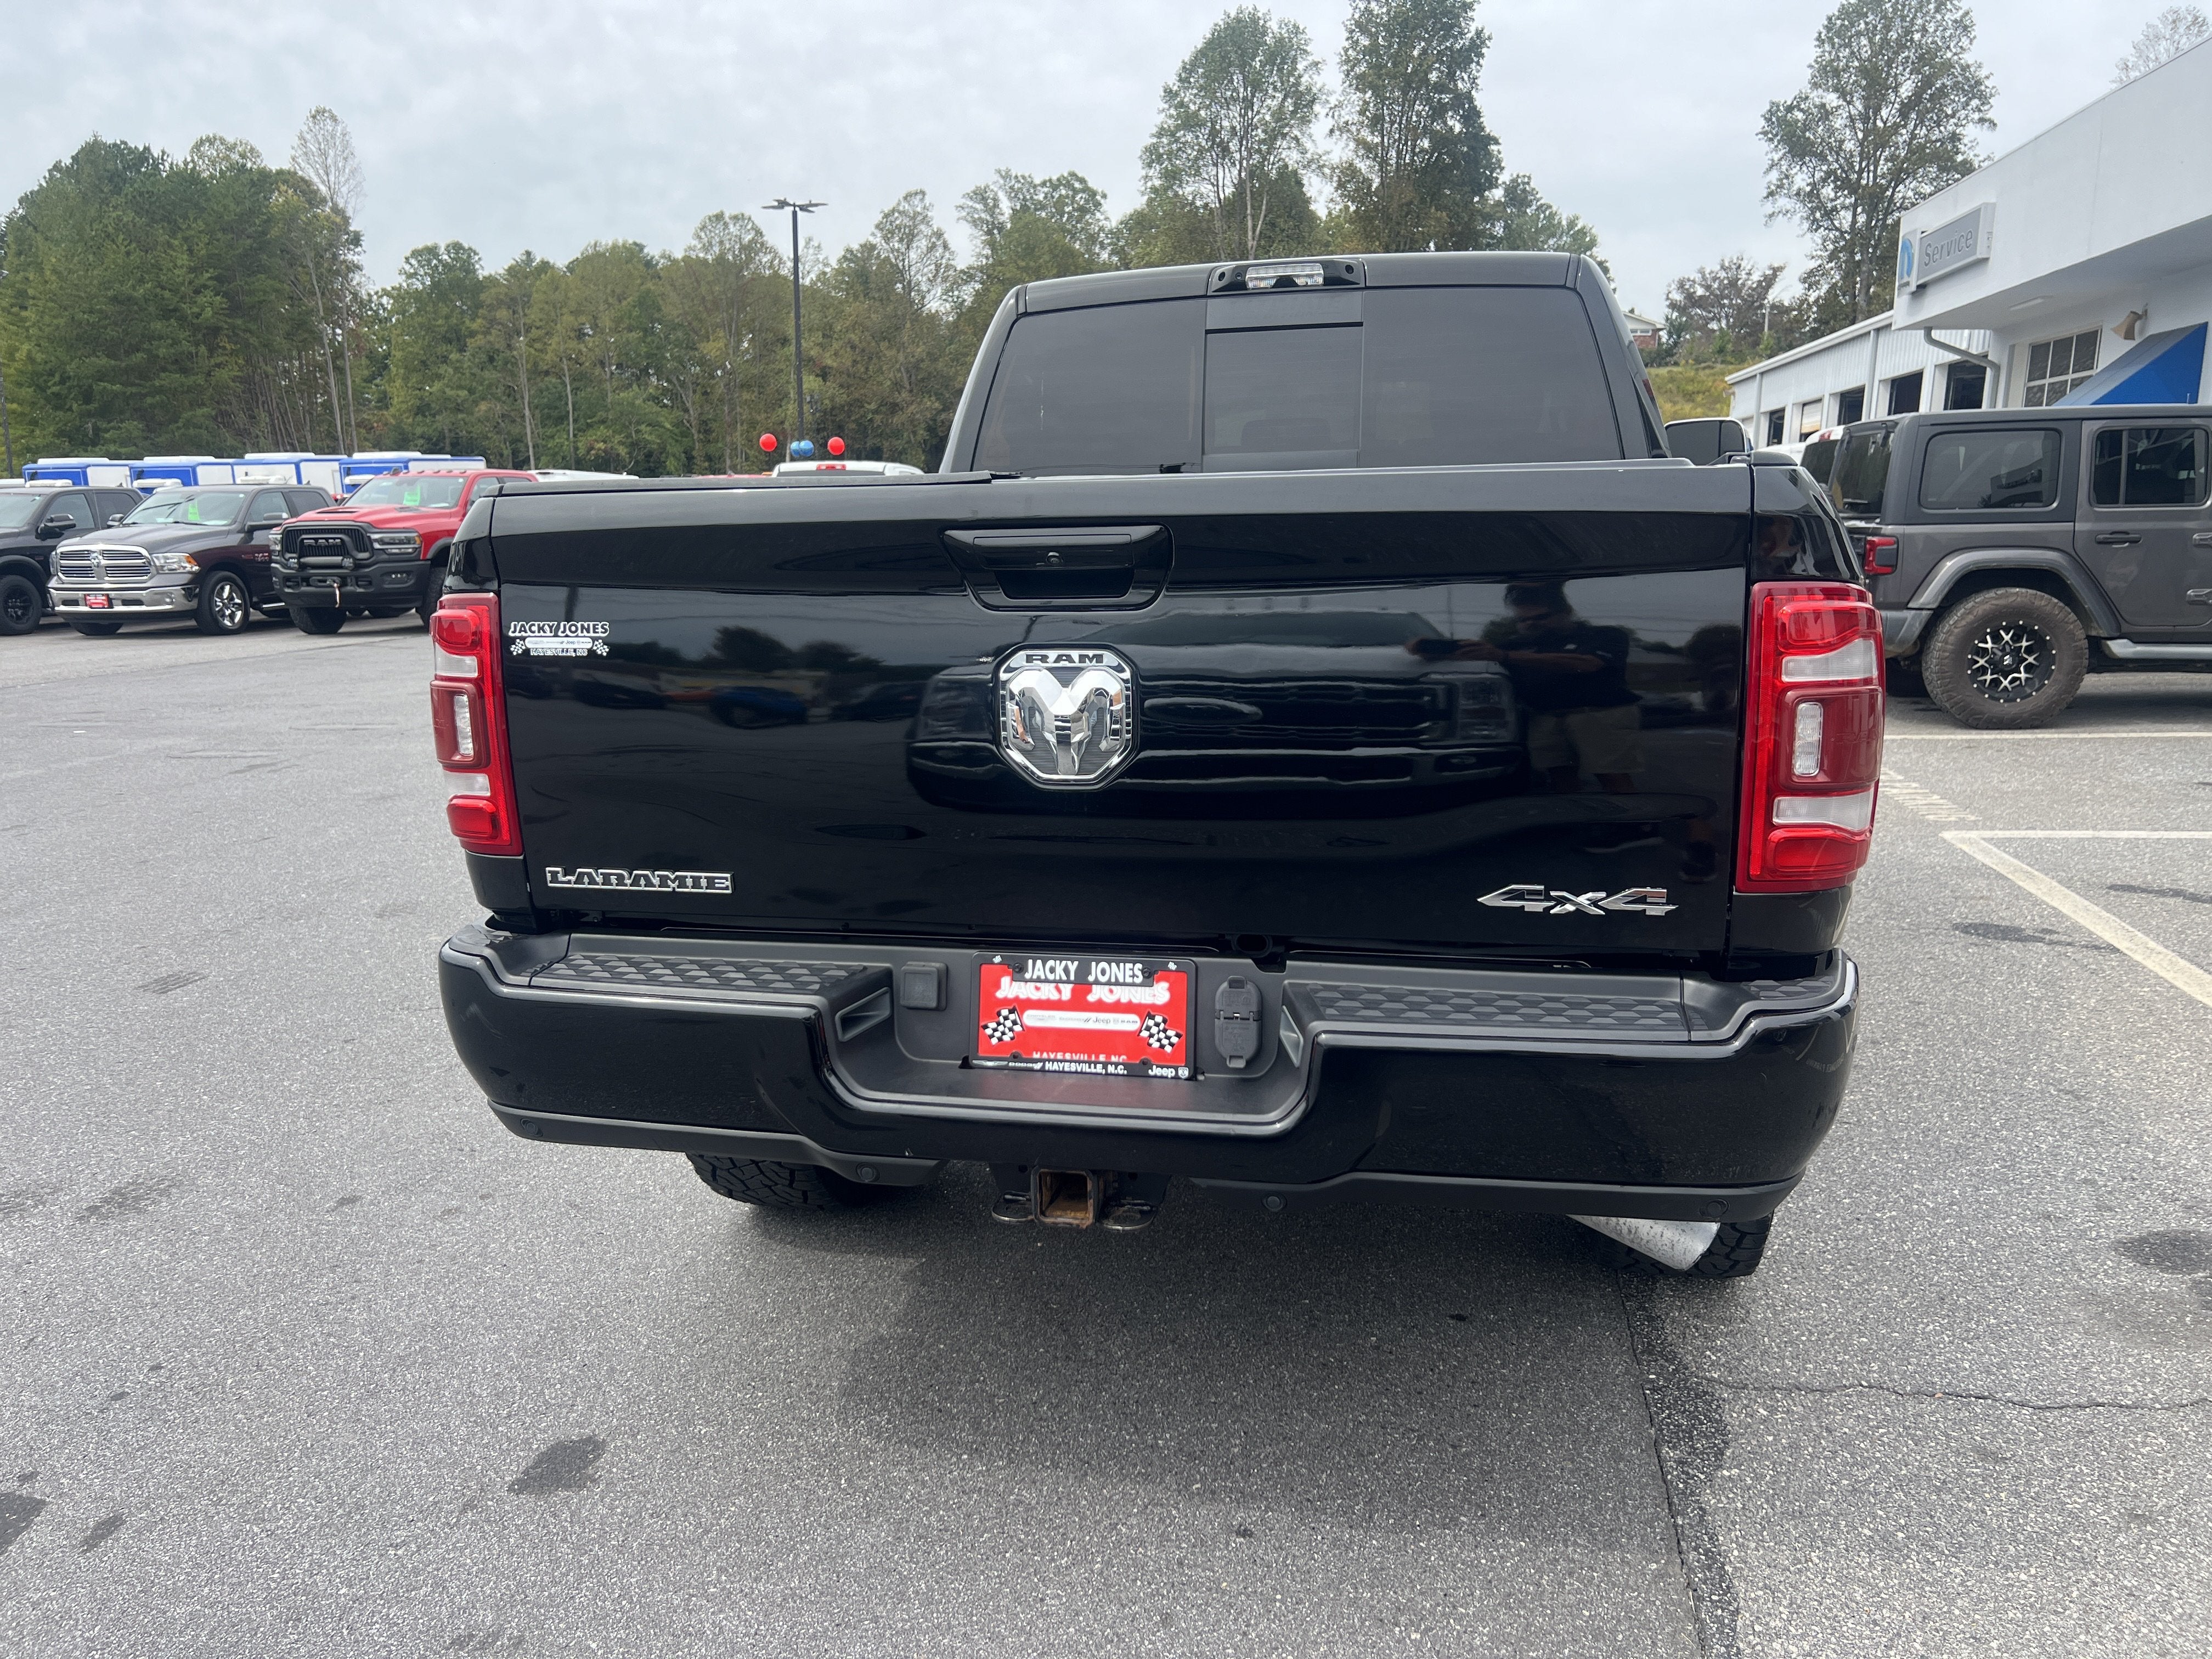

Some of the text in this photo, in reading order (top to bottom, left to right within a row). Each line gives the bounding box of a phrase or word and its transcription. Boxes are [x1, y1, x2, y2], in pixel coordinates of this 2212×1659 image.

[1924, 229, 1973, 267] Service
[509, 622, 609, 636] JACKY JONES
[1025, 653, 1104, 664] RAM
[545, 866, 734, 894] LARAMIE
[1024, 959, 1143, 984] JACKY JONES
[996, 976, 1170, 1005] JACKY JONES
[1093, 1017, 1111, 1025] Jeep
[1045, 1061, 1105, 1074] HAYESVILLE,
[1108, 1064, 1127, 1074] N.C.
[1148, 1065, 1176, 1078] Jeep
